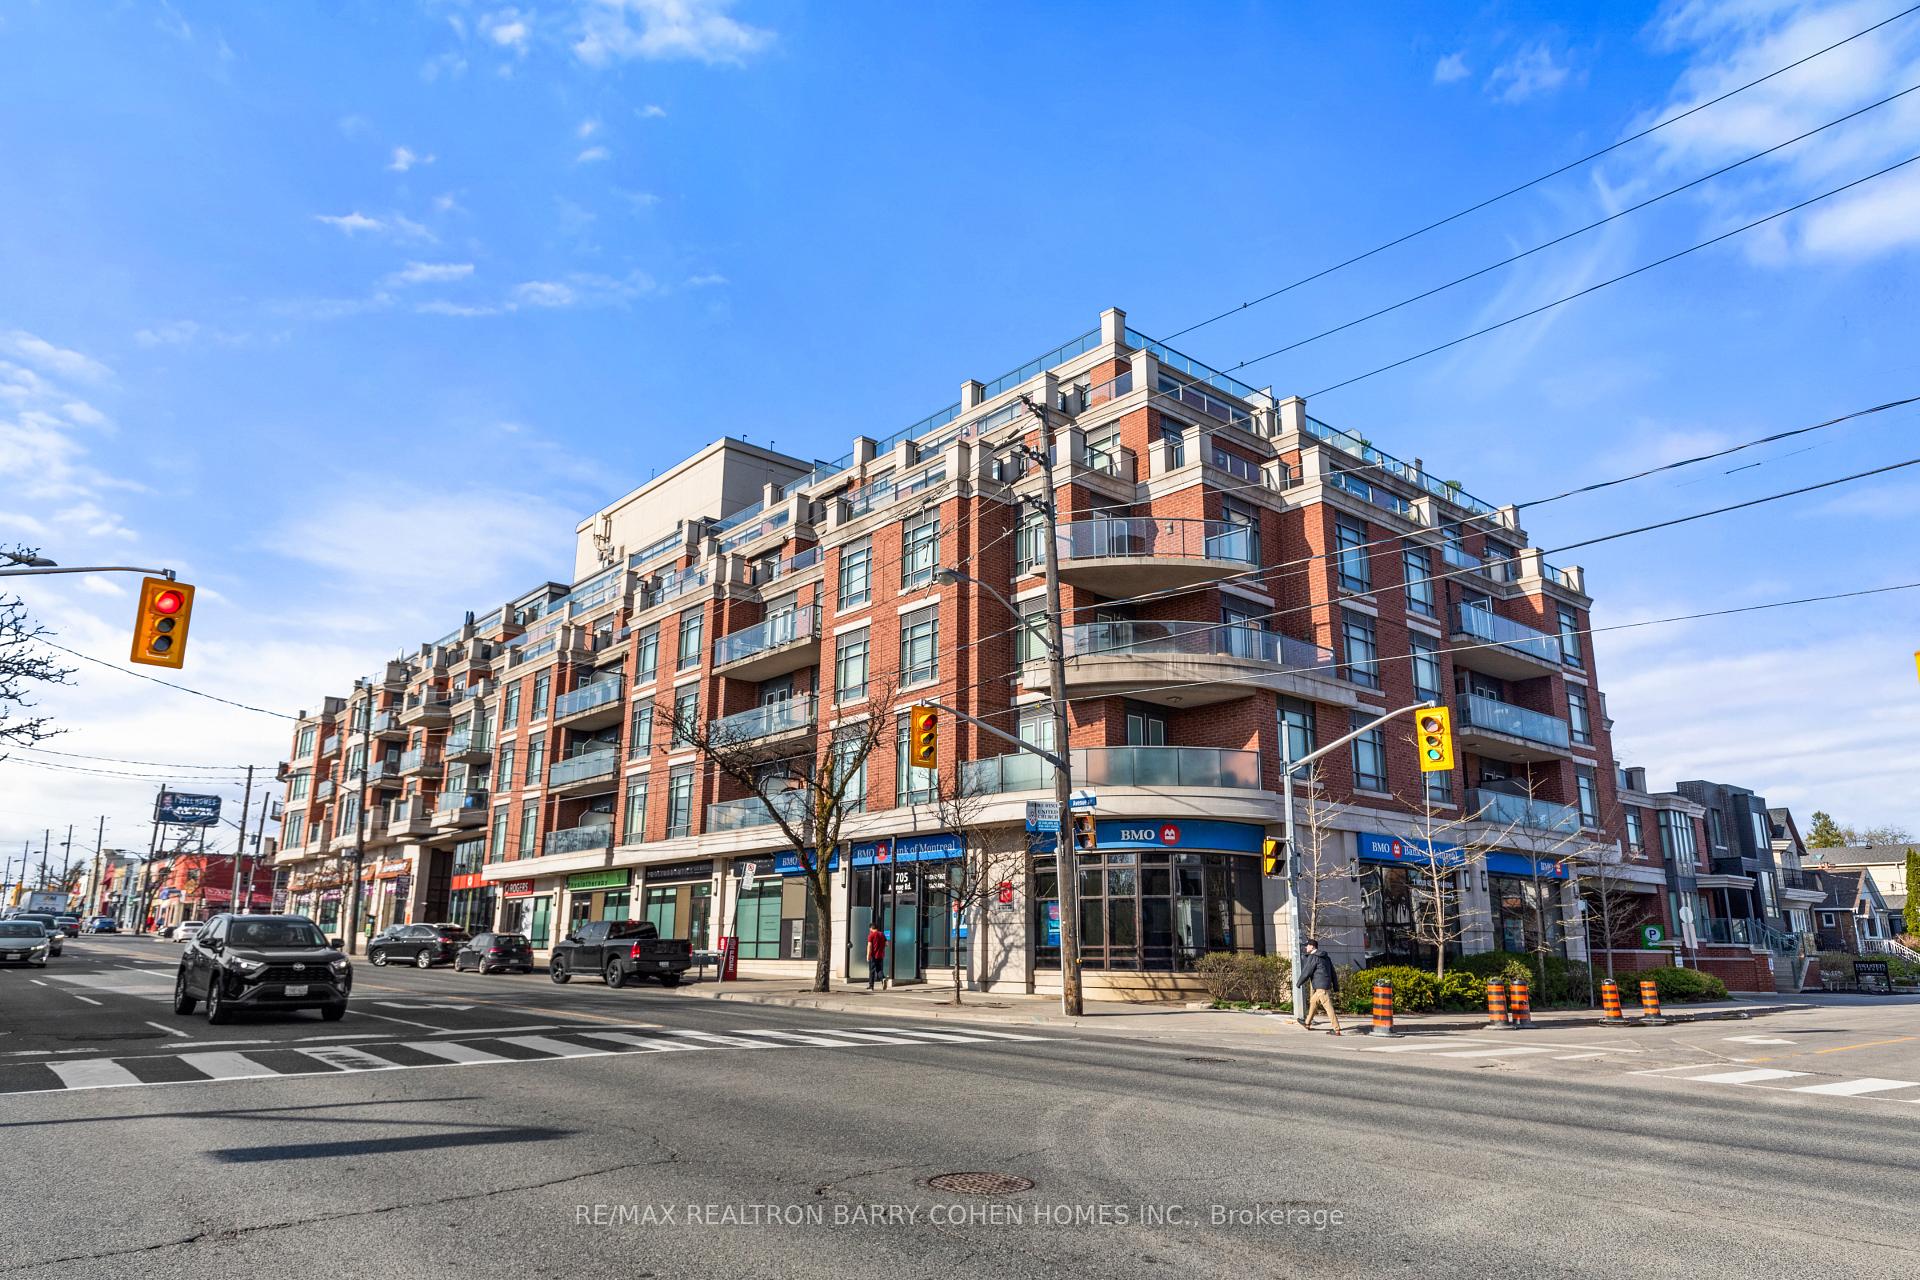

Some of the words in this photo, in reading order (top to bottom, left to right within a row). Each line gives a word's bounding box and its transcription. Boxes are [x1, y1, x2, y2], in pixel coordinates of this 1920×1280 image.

[1120, 829, 1155, 840] BMO
[857, 848, 874, 858] BMO
[919, 840, 955, 853] Montreal
[1372, 841, 1390, 853] BMO
[782, 857, 798, 866] BMO
[509, 882, 529, 893] ROGERS
[1648, 930, 1657, 939] P
